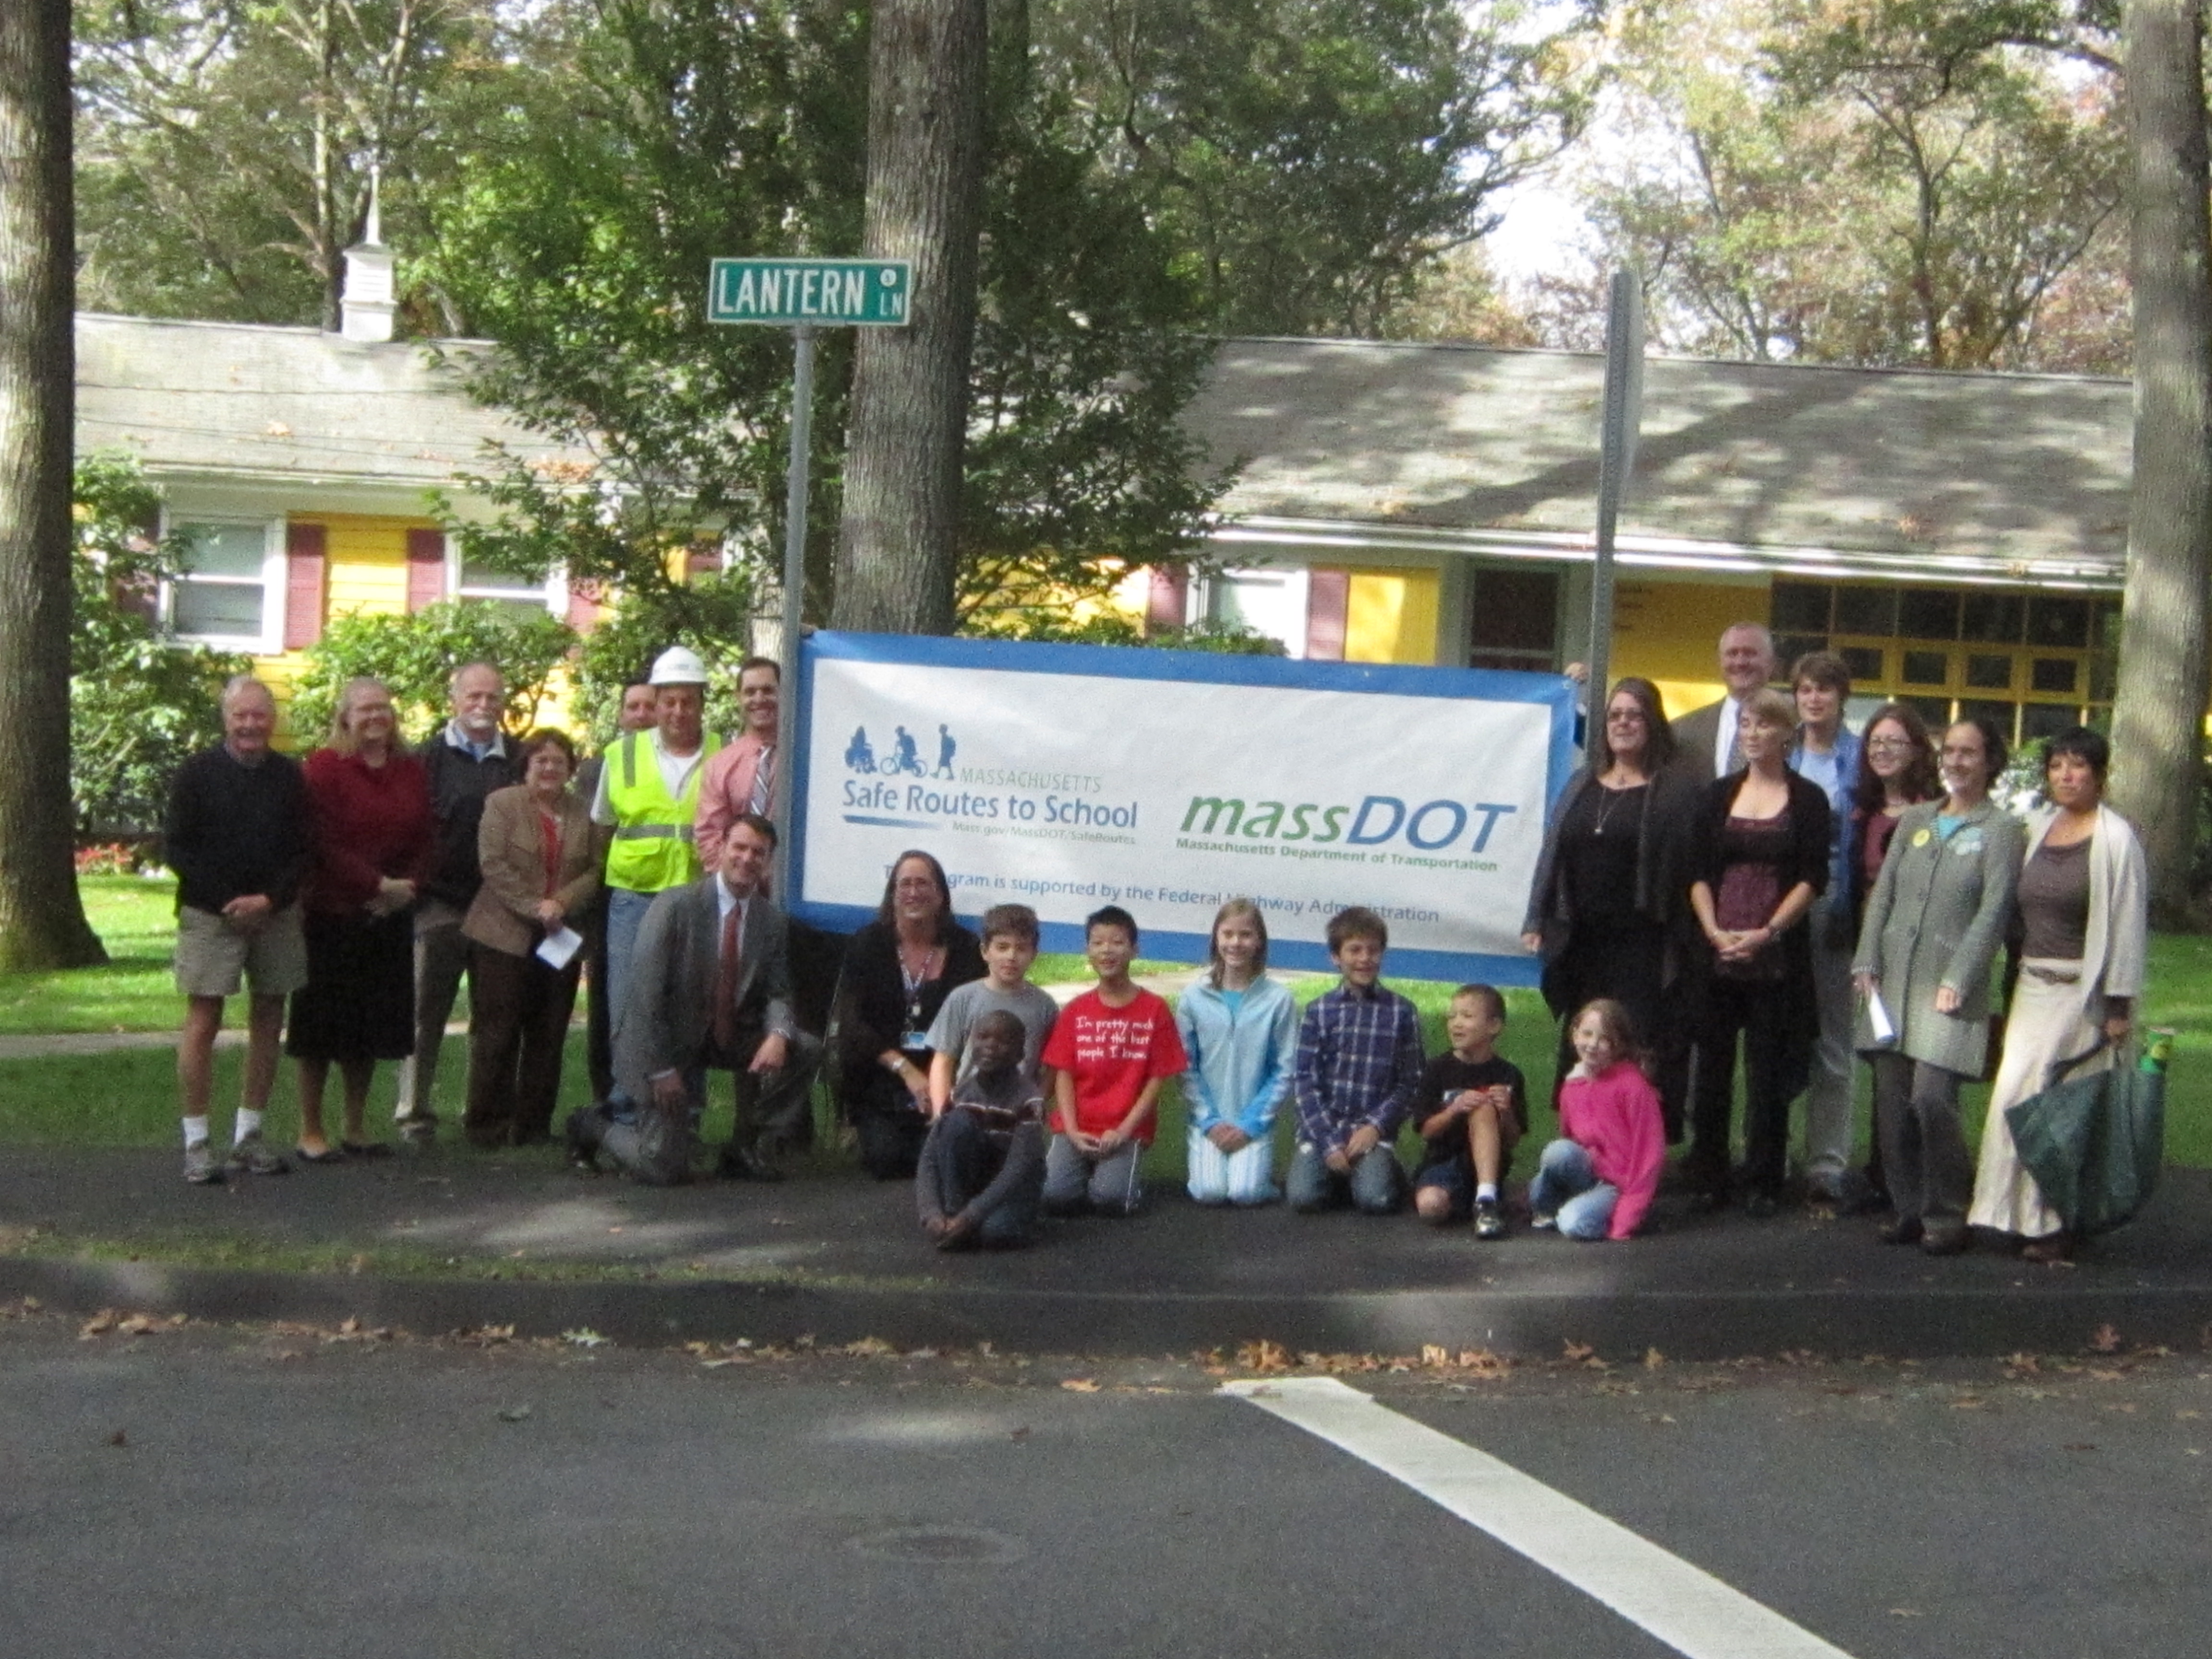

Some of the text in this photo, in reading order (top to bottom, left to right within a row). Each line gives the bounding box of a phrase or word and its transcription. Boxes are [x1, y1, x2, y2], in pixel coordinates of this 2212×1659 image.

[718, 269, 902, 315] LANTERN LN
[960, 768, 1101, 793] MASSACHUSETTS
[842, 780, 1137, 828] Safe Routes to School
[1180, 795, 1518, 854] massDOT
[1176, 838, 1498, 872] Massachusetts Department of Transportation
[994, 875, 1006, 888] is
[1011, 878, 1096, 896] supported
[1102, 885, 1121, 902] by
[1126, 886, 1153, 900] the
[1159, 888, 1221, 905] Federal
[1077, 1034, 1092, 1043] one
[1095, 1032, 1106, 1043] of
[1110, 1032, 1126, 1045] the
[1095, 1019, 1129, 1036] pretty
[1132, 1017, 1153, 1031] much
[1077, 1046, 1104, 1062] people
[1109, 1045, 1118, 1058] I
